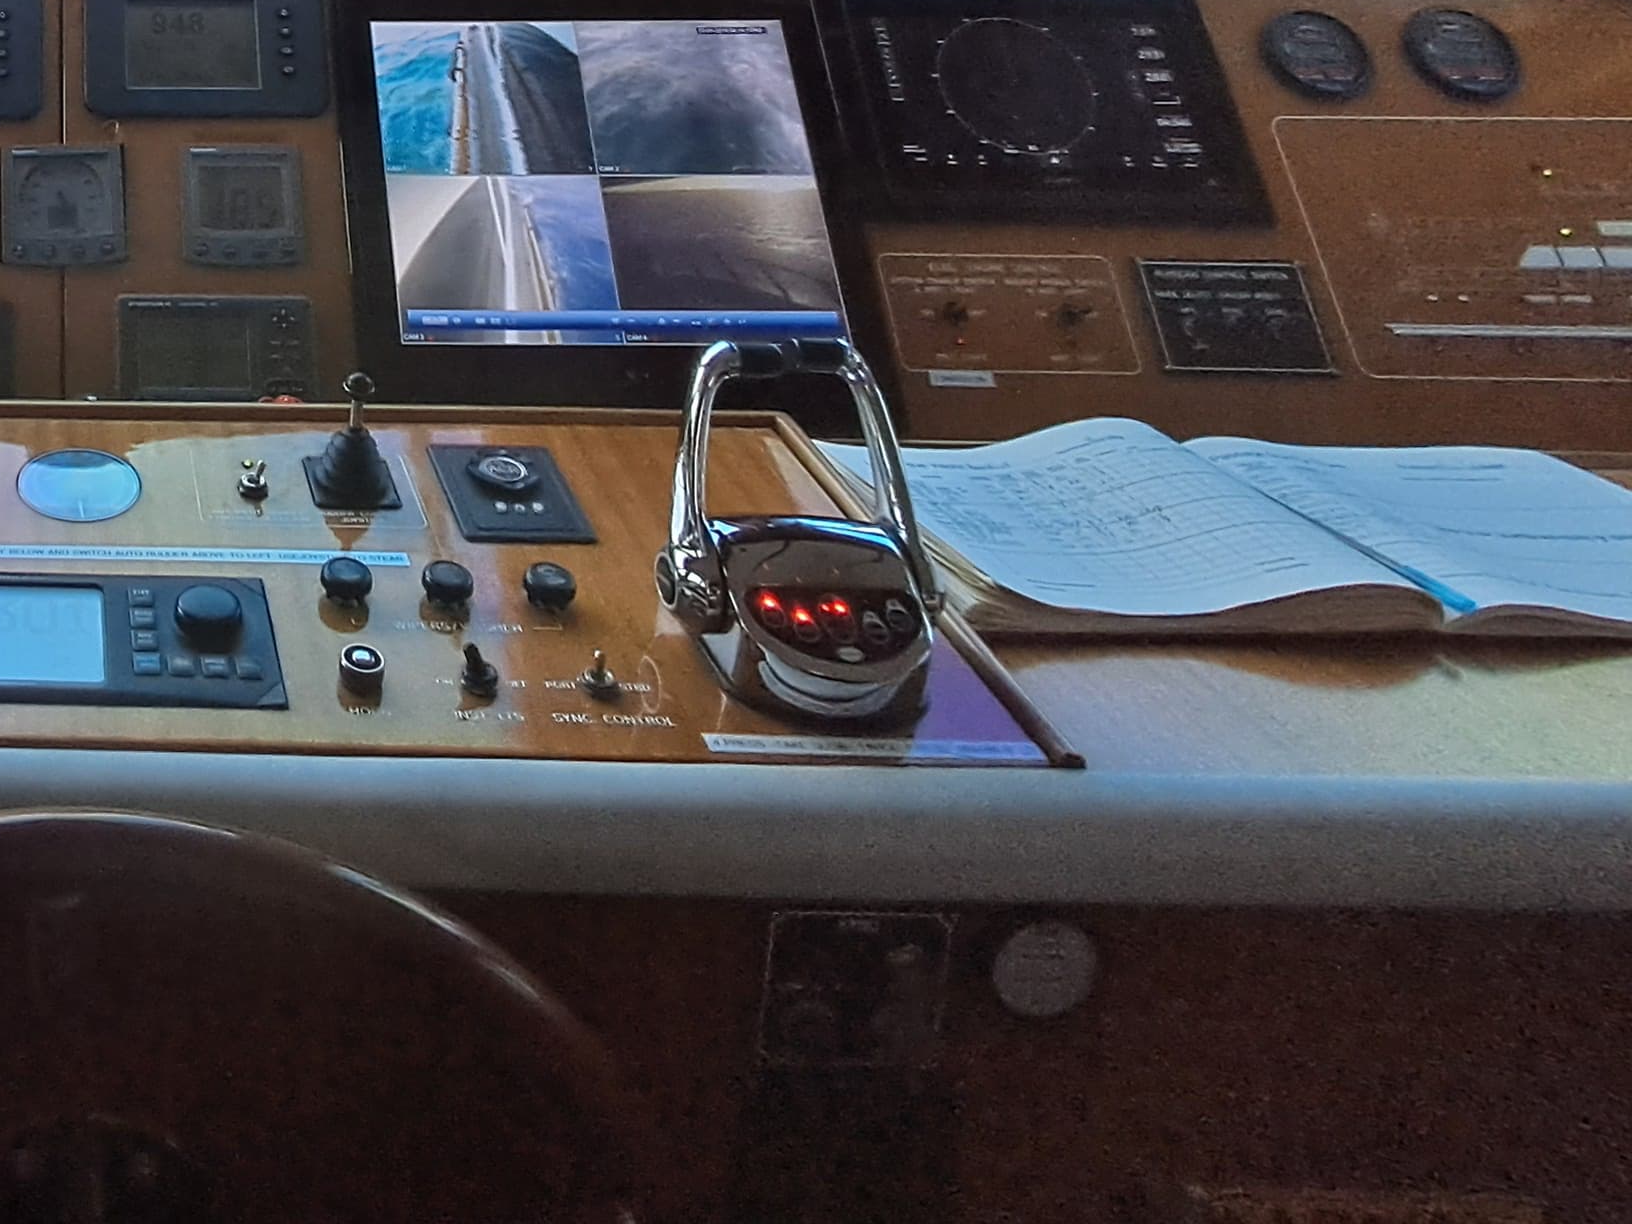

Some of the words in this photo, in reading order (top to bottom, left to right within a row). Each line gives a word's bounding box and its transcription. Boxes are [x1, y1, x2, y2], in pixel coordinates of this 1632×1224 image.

[152, 11, 205, 34] 948
[552, 713, 592, 724] SYNC
[602, 715, 676, 727] CONTROL
